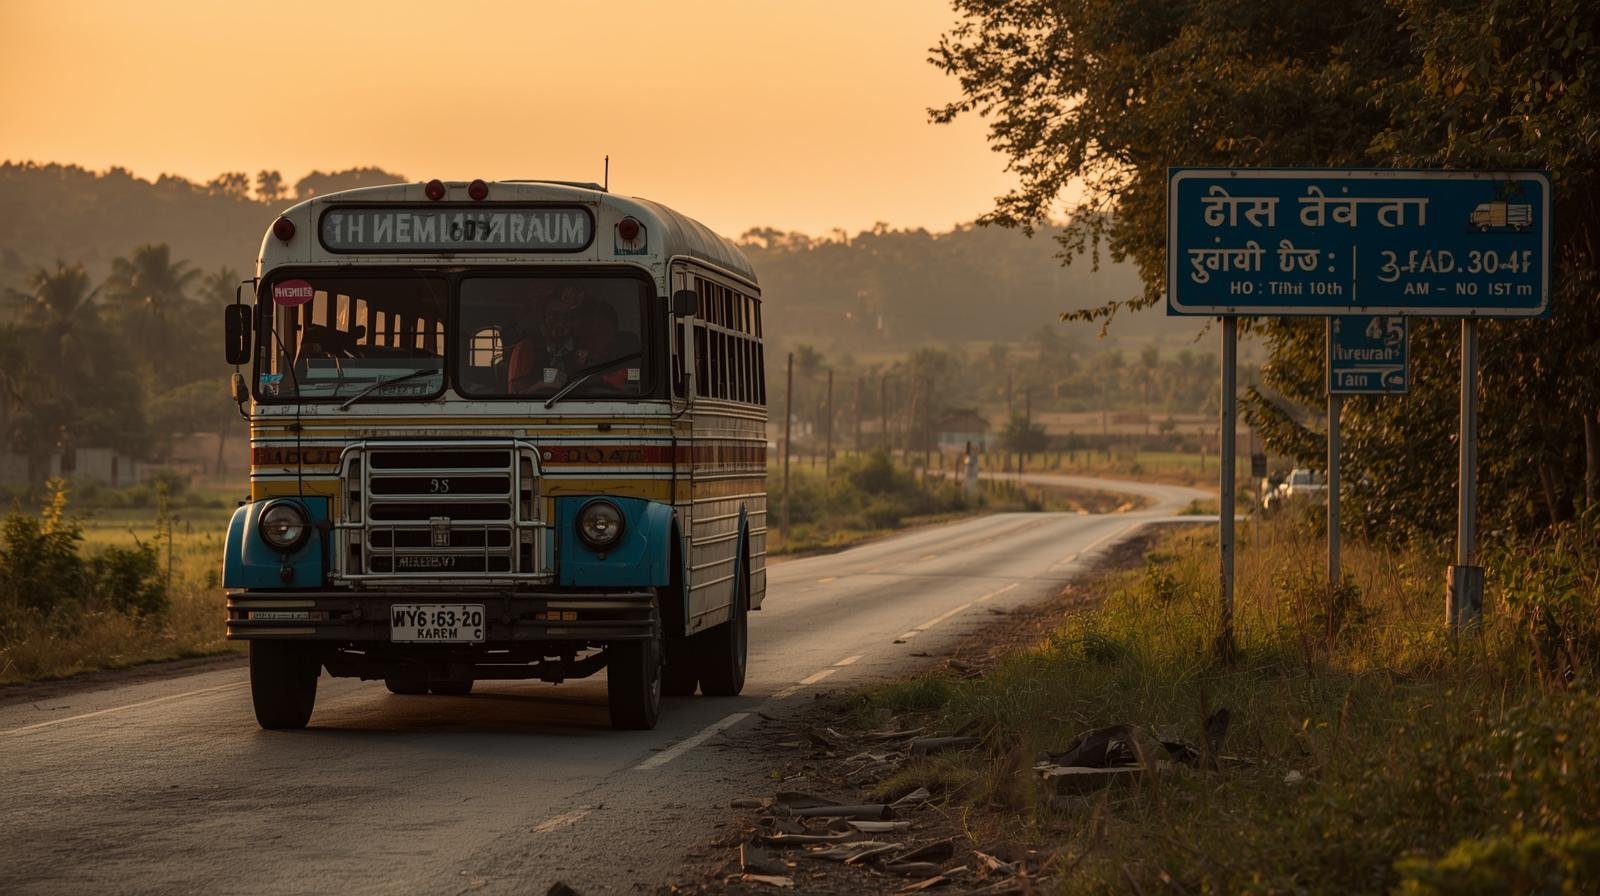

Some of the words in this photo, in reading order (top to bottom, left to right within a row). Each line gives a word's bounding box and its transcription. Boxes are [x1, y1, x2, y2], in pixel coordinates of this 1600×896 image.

[1309, 281, 1343, 295] 10th
[1404, 282, 1429, 295] AM
[1456, 282, 1478, 295] NO
